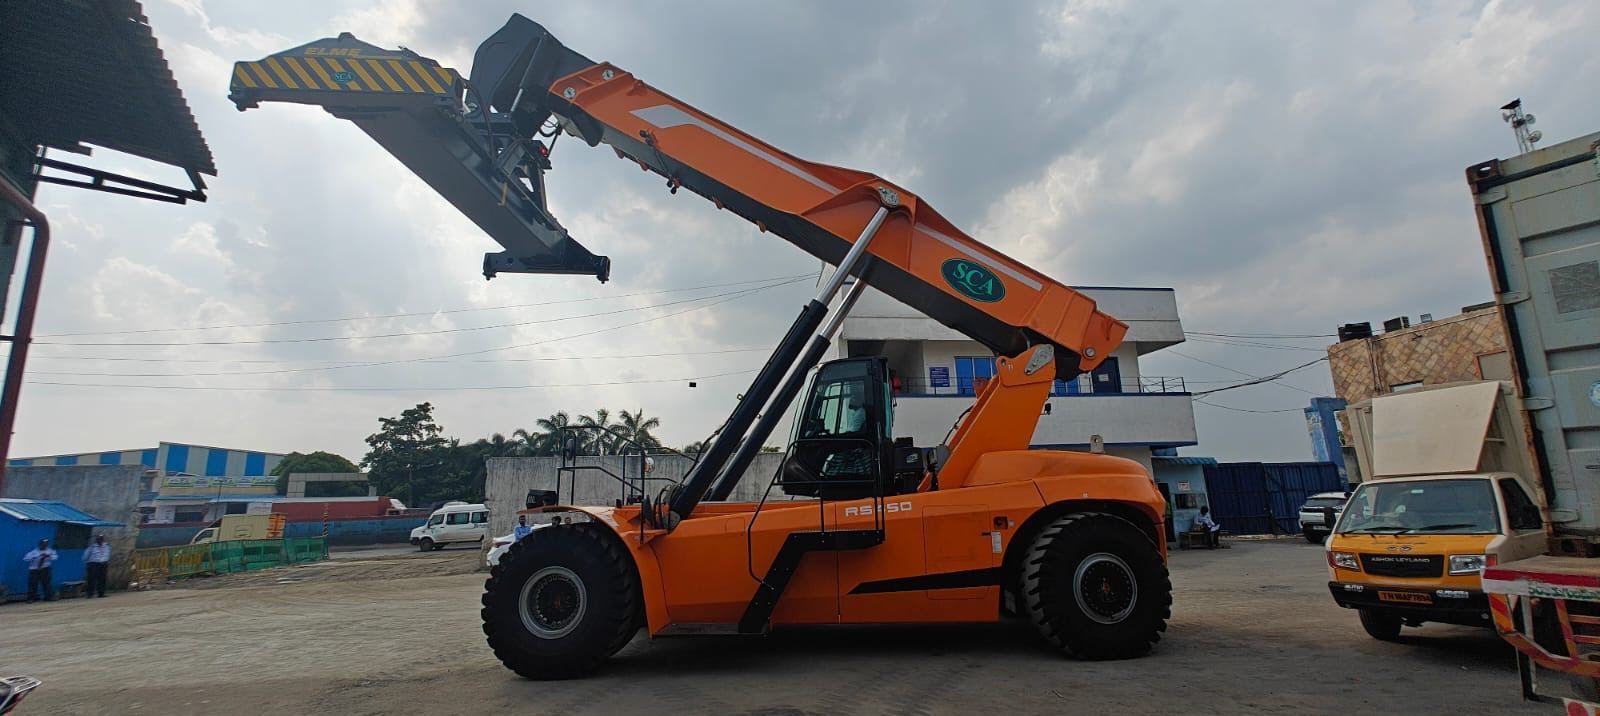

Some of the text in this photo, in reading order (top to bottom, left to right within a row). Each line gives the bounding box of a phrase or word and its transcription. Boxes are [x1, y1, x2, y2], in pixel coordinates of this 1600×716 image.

[304, 47, 361, 56] ELME
[335, 71, 353, 81] SCA
[952, 262, 993, 296] SCA
